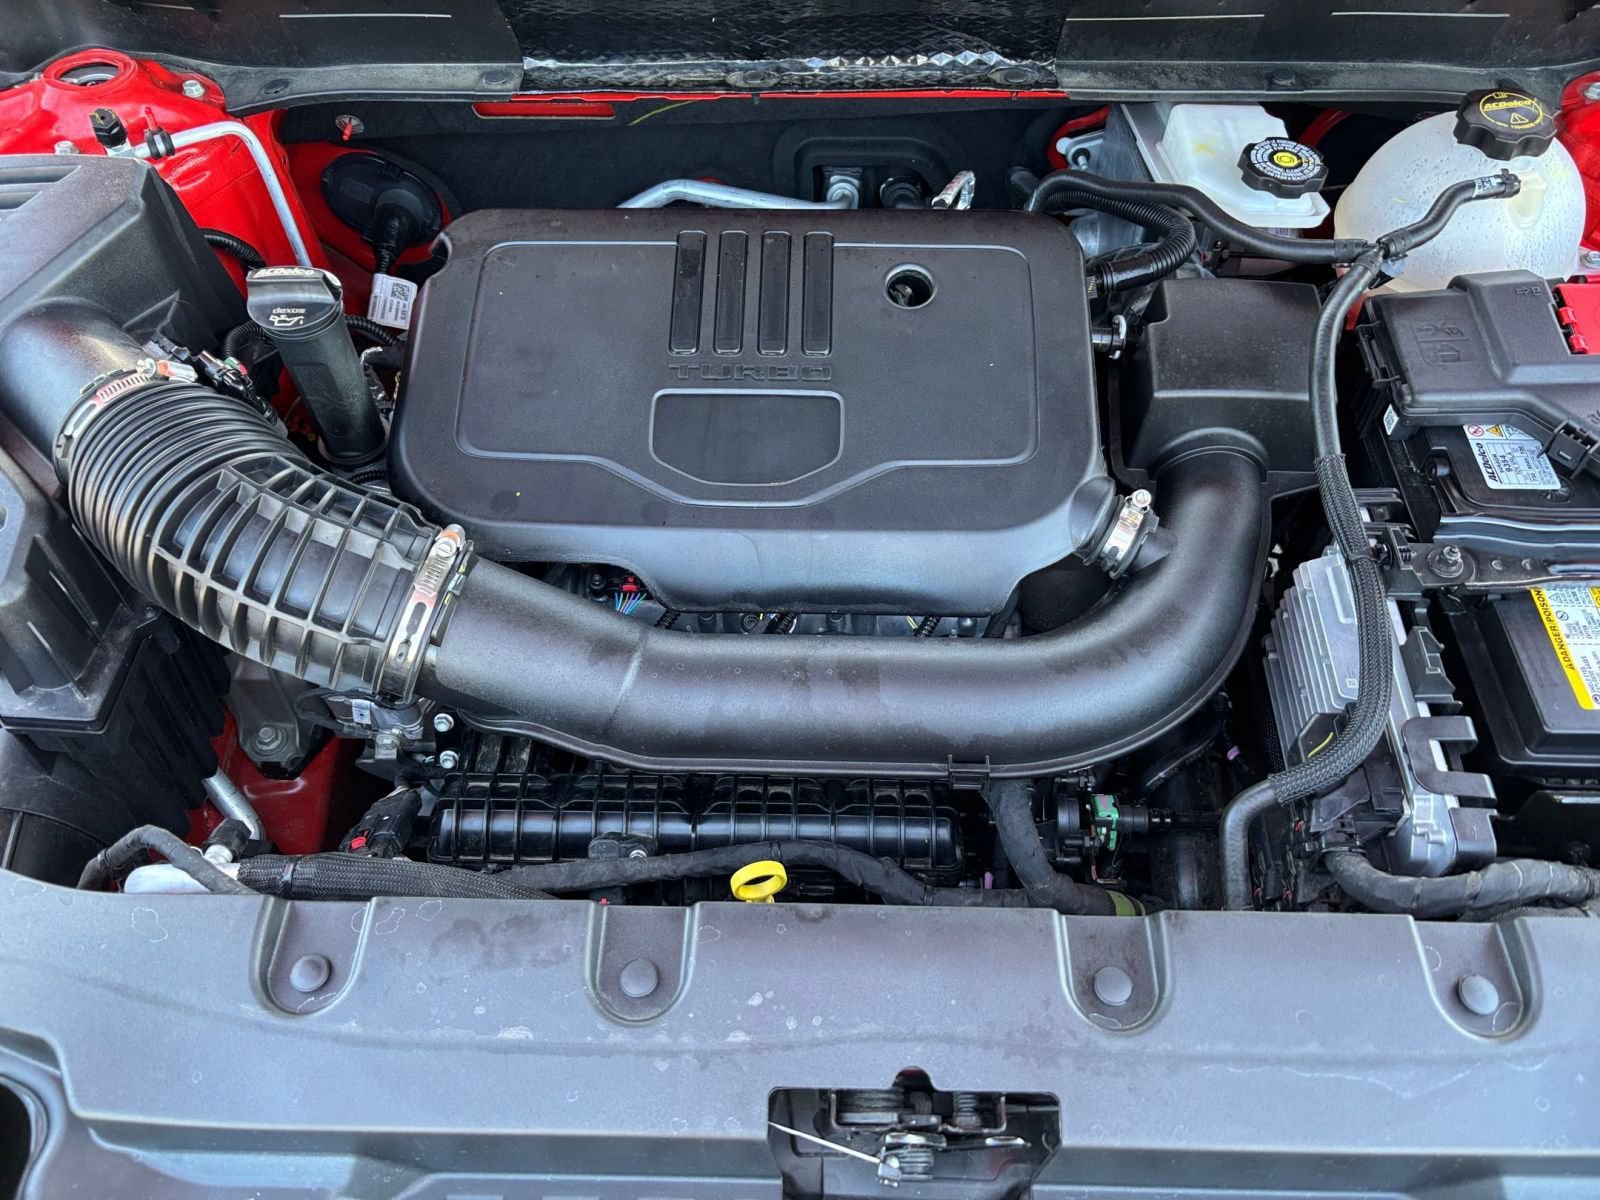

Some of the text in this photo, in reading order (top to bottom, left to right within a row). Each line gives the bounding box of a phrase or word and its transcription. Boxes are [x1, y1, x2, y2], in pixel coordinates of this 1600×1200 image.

[1483, 100, 1532, 111] ACDelco
[253, 267, 315, 278] ACDelco
[668, 363, 832, 381] TURBO
[1476, 442, 1498, 482] ACDelco
[1498, 455, 1513, 472] 9354
